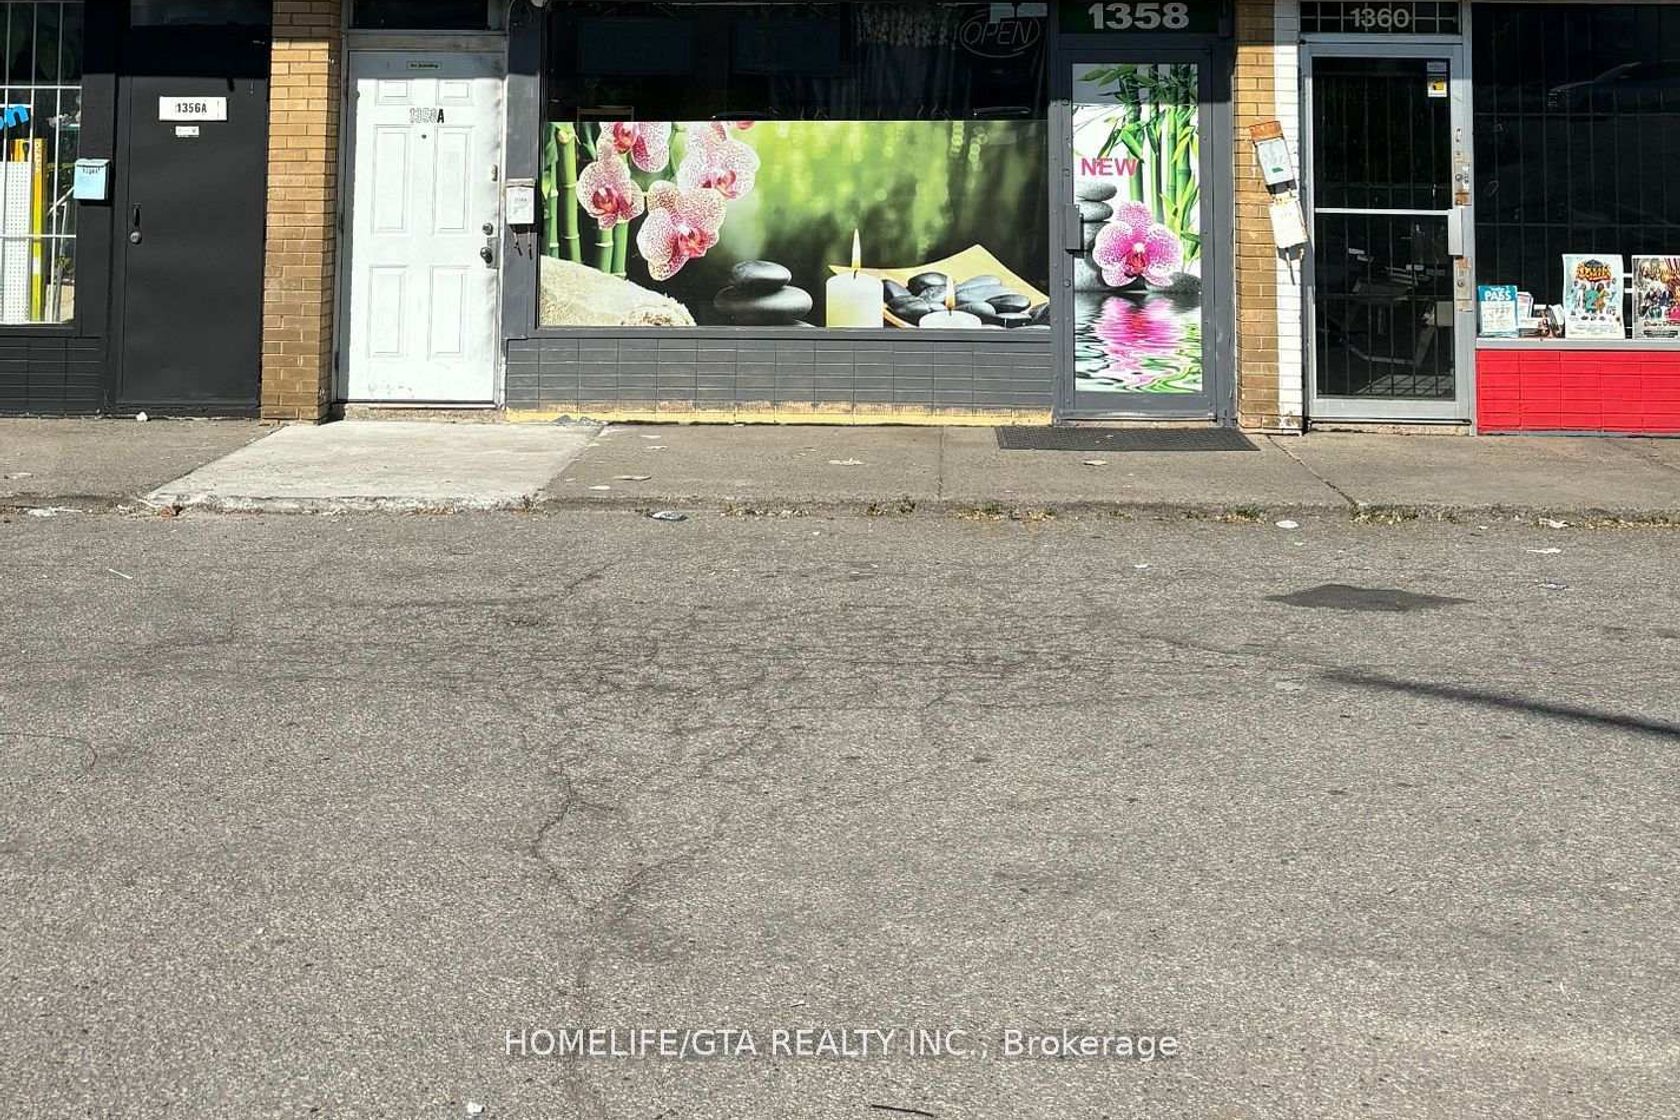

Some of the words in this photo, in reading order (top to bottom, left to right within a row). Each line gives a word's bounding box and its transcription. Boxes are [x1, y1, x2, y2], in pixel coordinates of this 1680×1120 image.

[1088, 2, 1190, 30] 1358
[1350, 8, 1410, 29] 1360
[963, 20, 1033, 45] OPEN
[1081, 157, 1139, 176] NEW
